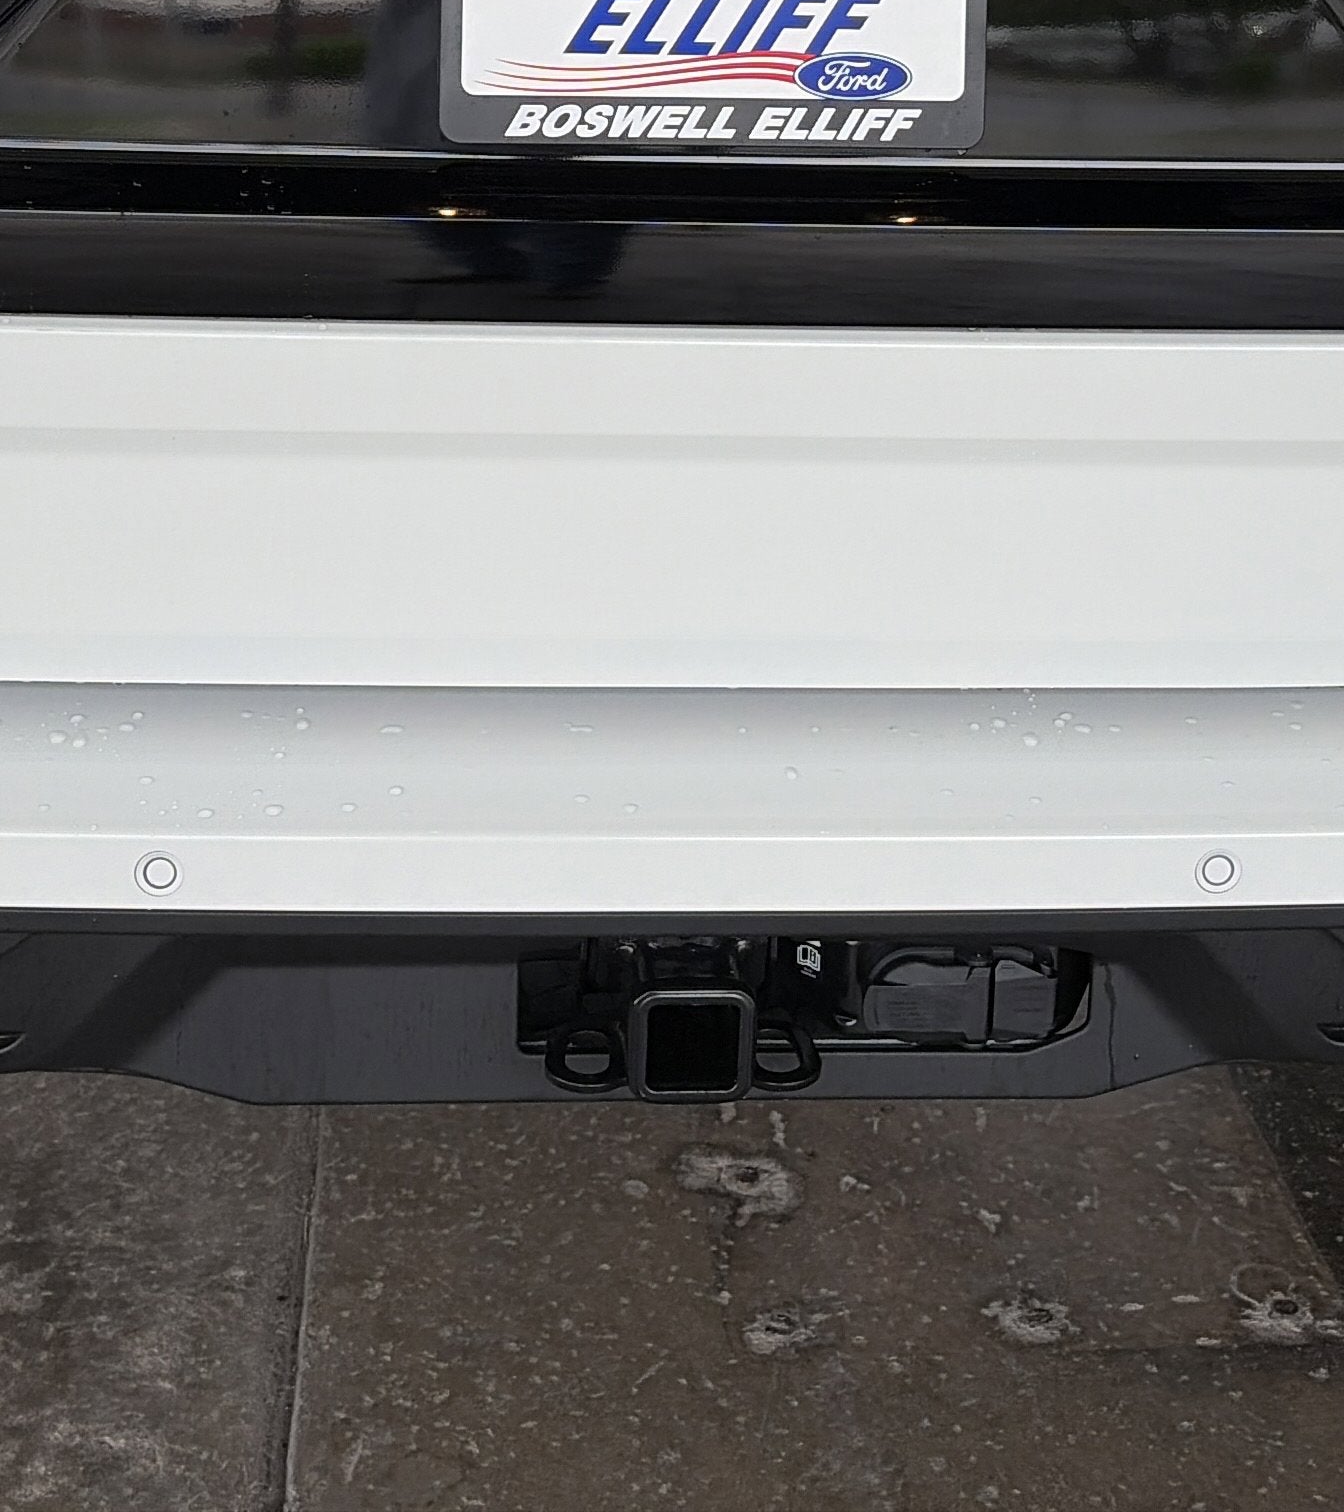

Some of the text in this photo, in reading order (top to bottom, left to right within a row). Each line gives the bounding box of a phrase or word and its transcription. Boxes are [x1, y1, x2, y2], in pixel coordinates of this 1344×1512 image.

[818, 59, 888, 92] Ford
[504, 103, 922, 142] BOSWELL ELLIFF
